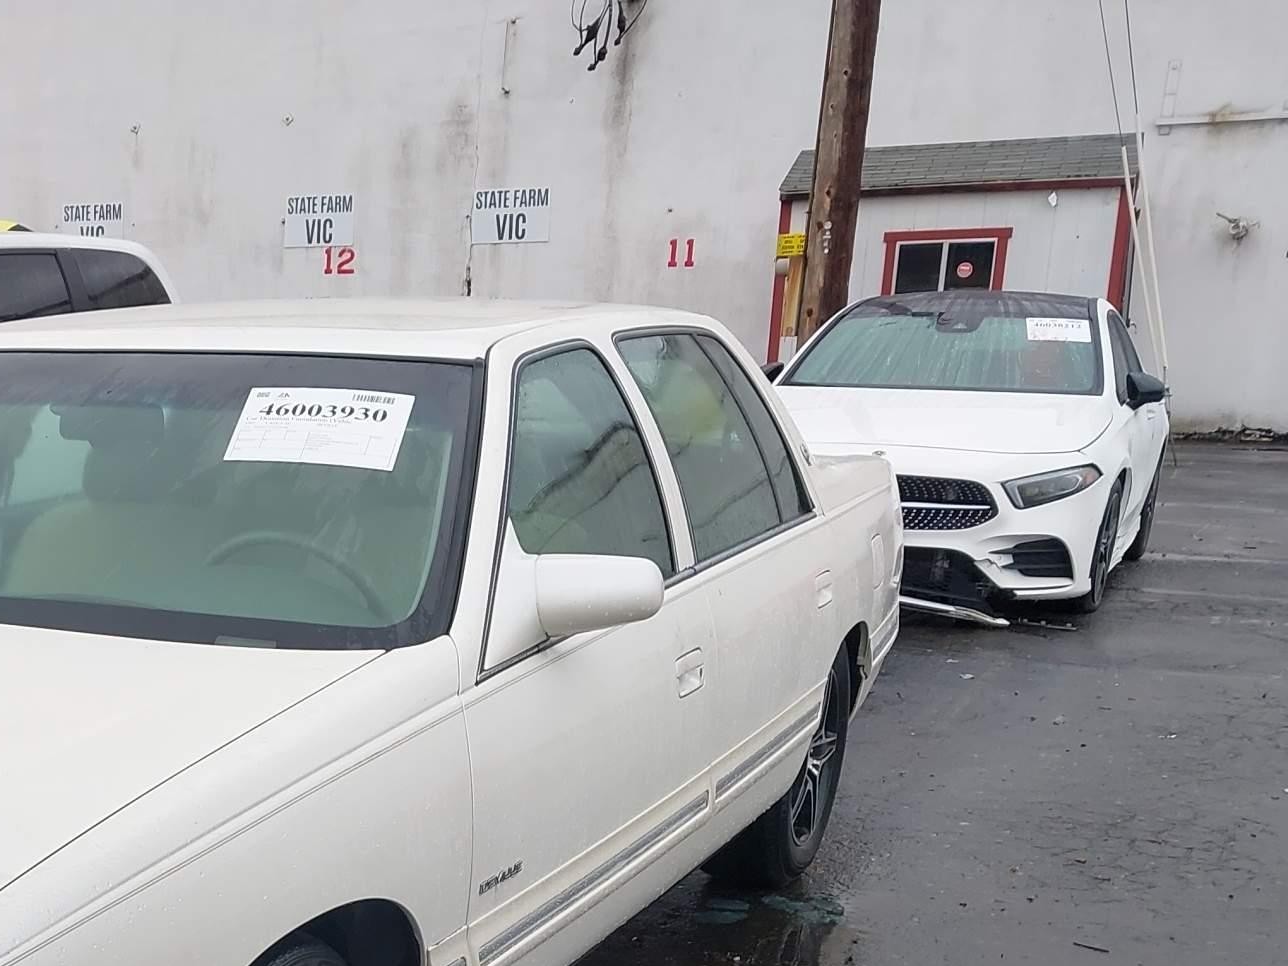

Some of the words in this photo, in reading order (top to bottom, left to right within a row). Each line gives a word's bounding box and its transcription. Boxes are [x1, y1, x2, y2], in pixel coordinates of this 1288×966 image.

[287, 196, 318, 215] STATE
[320, 194, 353, 214] FARM
[475, 190, 510, 210] STATE
[513, 188, 549, 208] FARM
[63, 204, 91, 222] STATE
[93, 203, 122, 221] FARM
[305, 218, 333, 245] VIC
[495, 212, 527, 241] VIC
[324, 246, 355, 275] 12
[667, 238, 695, 268] 11
[259, 402, 389, 423] 46003930
